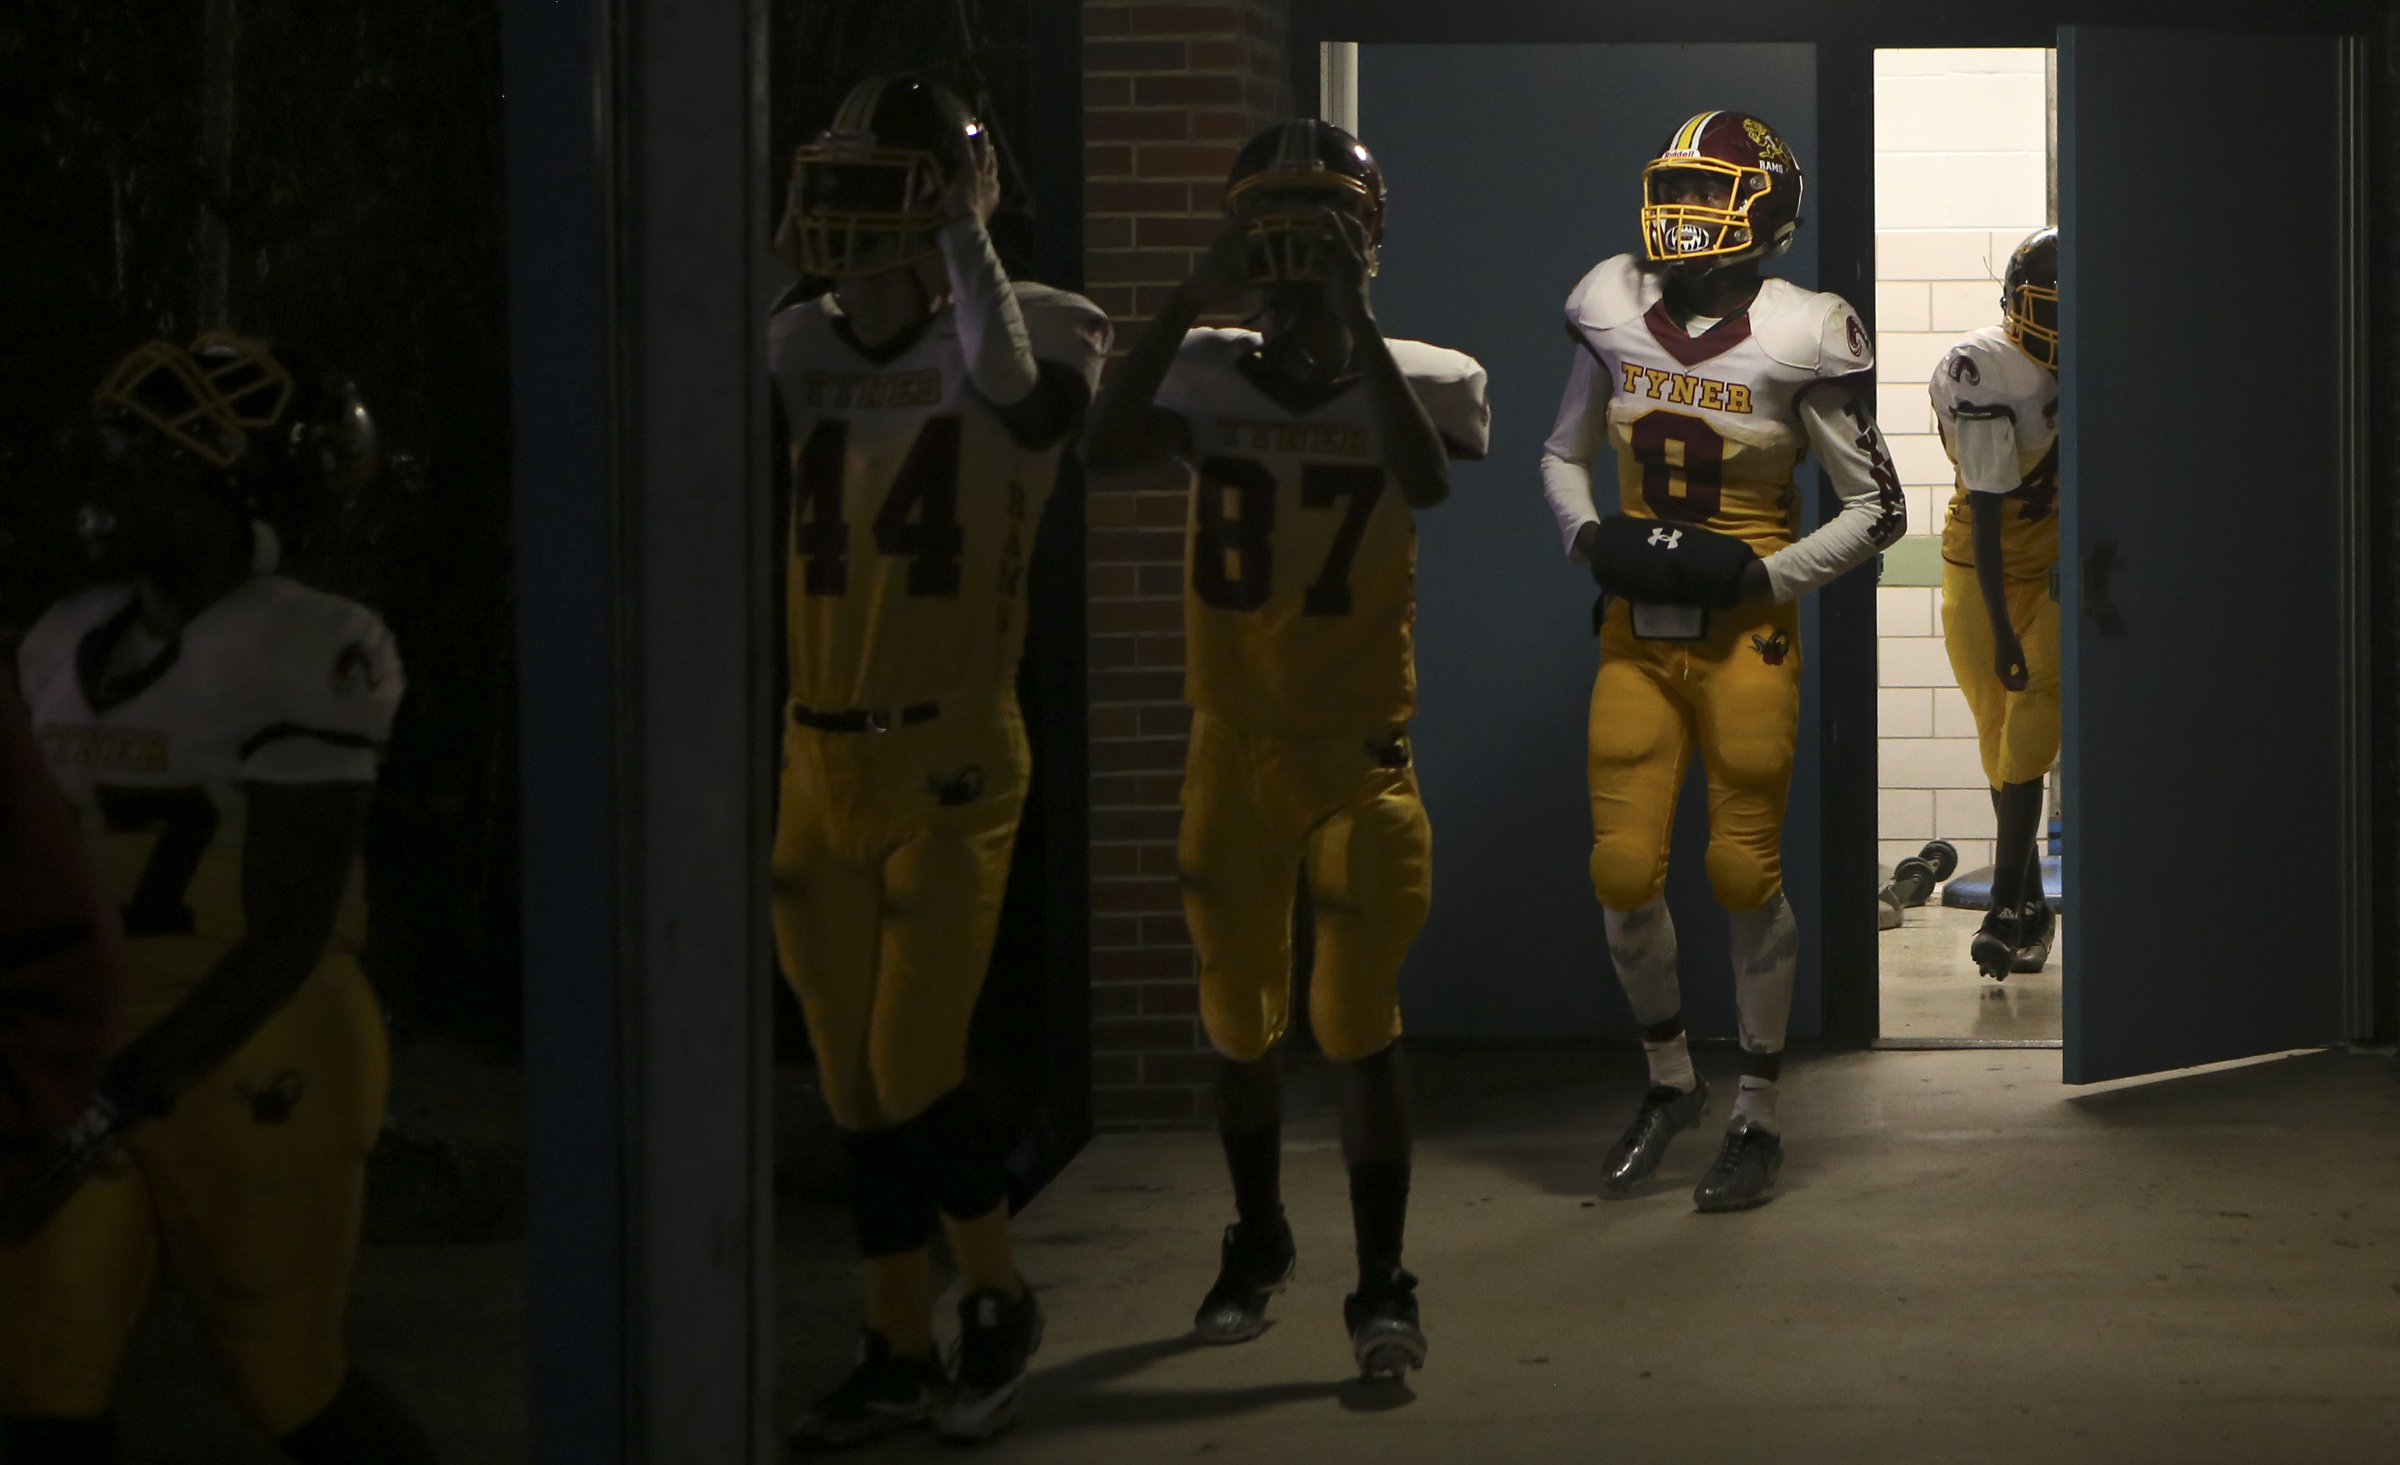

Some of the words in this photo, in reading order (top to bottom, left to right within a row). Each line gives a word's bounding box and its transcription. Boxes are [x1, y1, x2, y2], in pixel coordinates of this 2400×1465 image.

[1758, 159, 1784, 174] RAMS
[1621, 361, 1753, 414] TYNER
[1192, 455, 1385, 616] 87
[97, 782, 220, 940] 7
